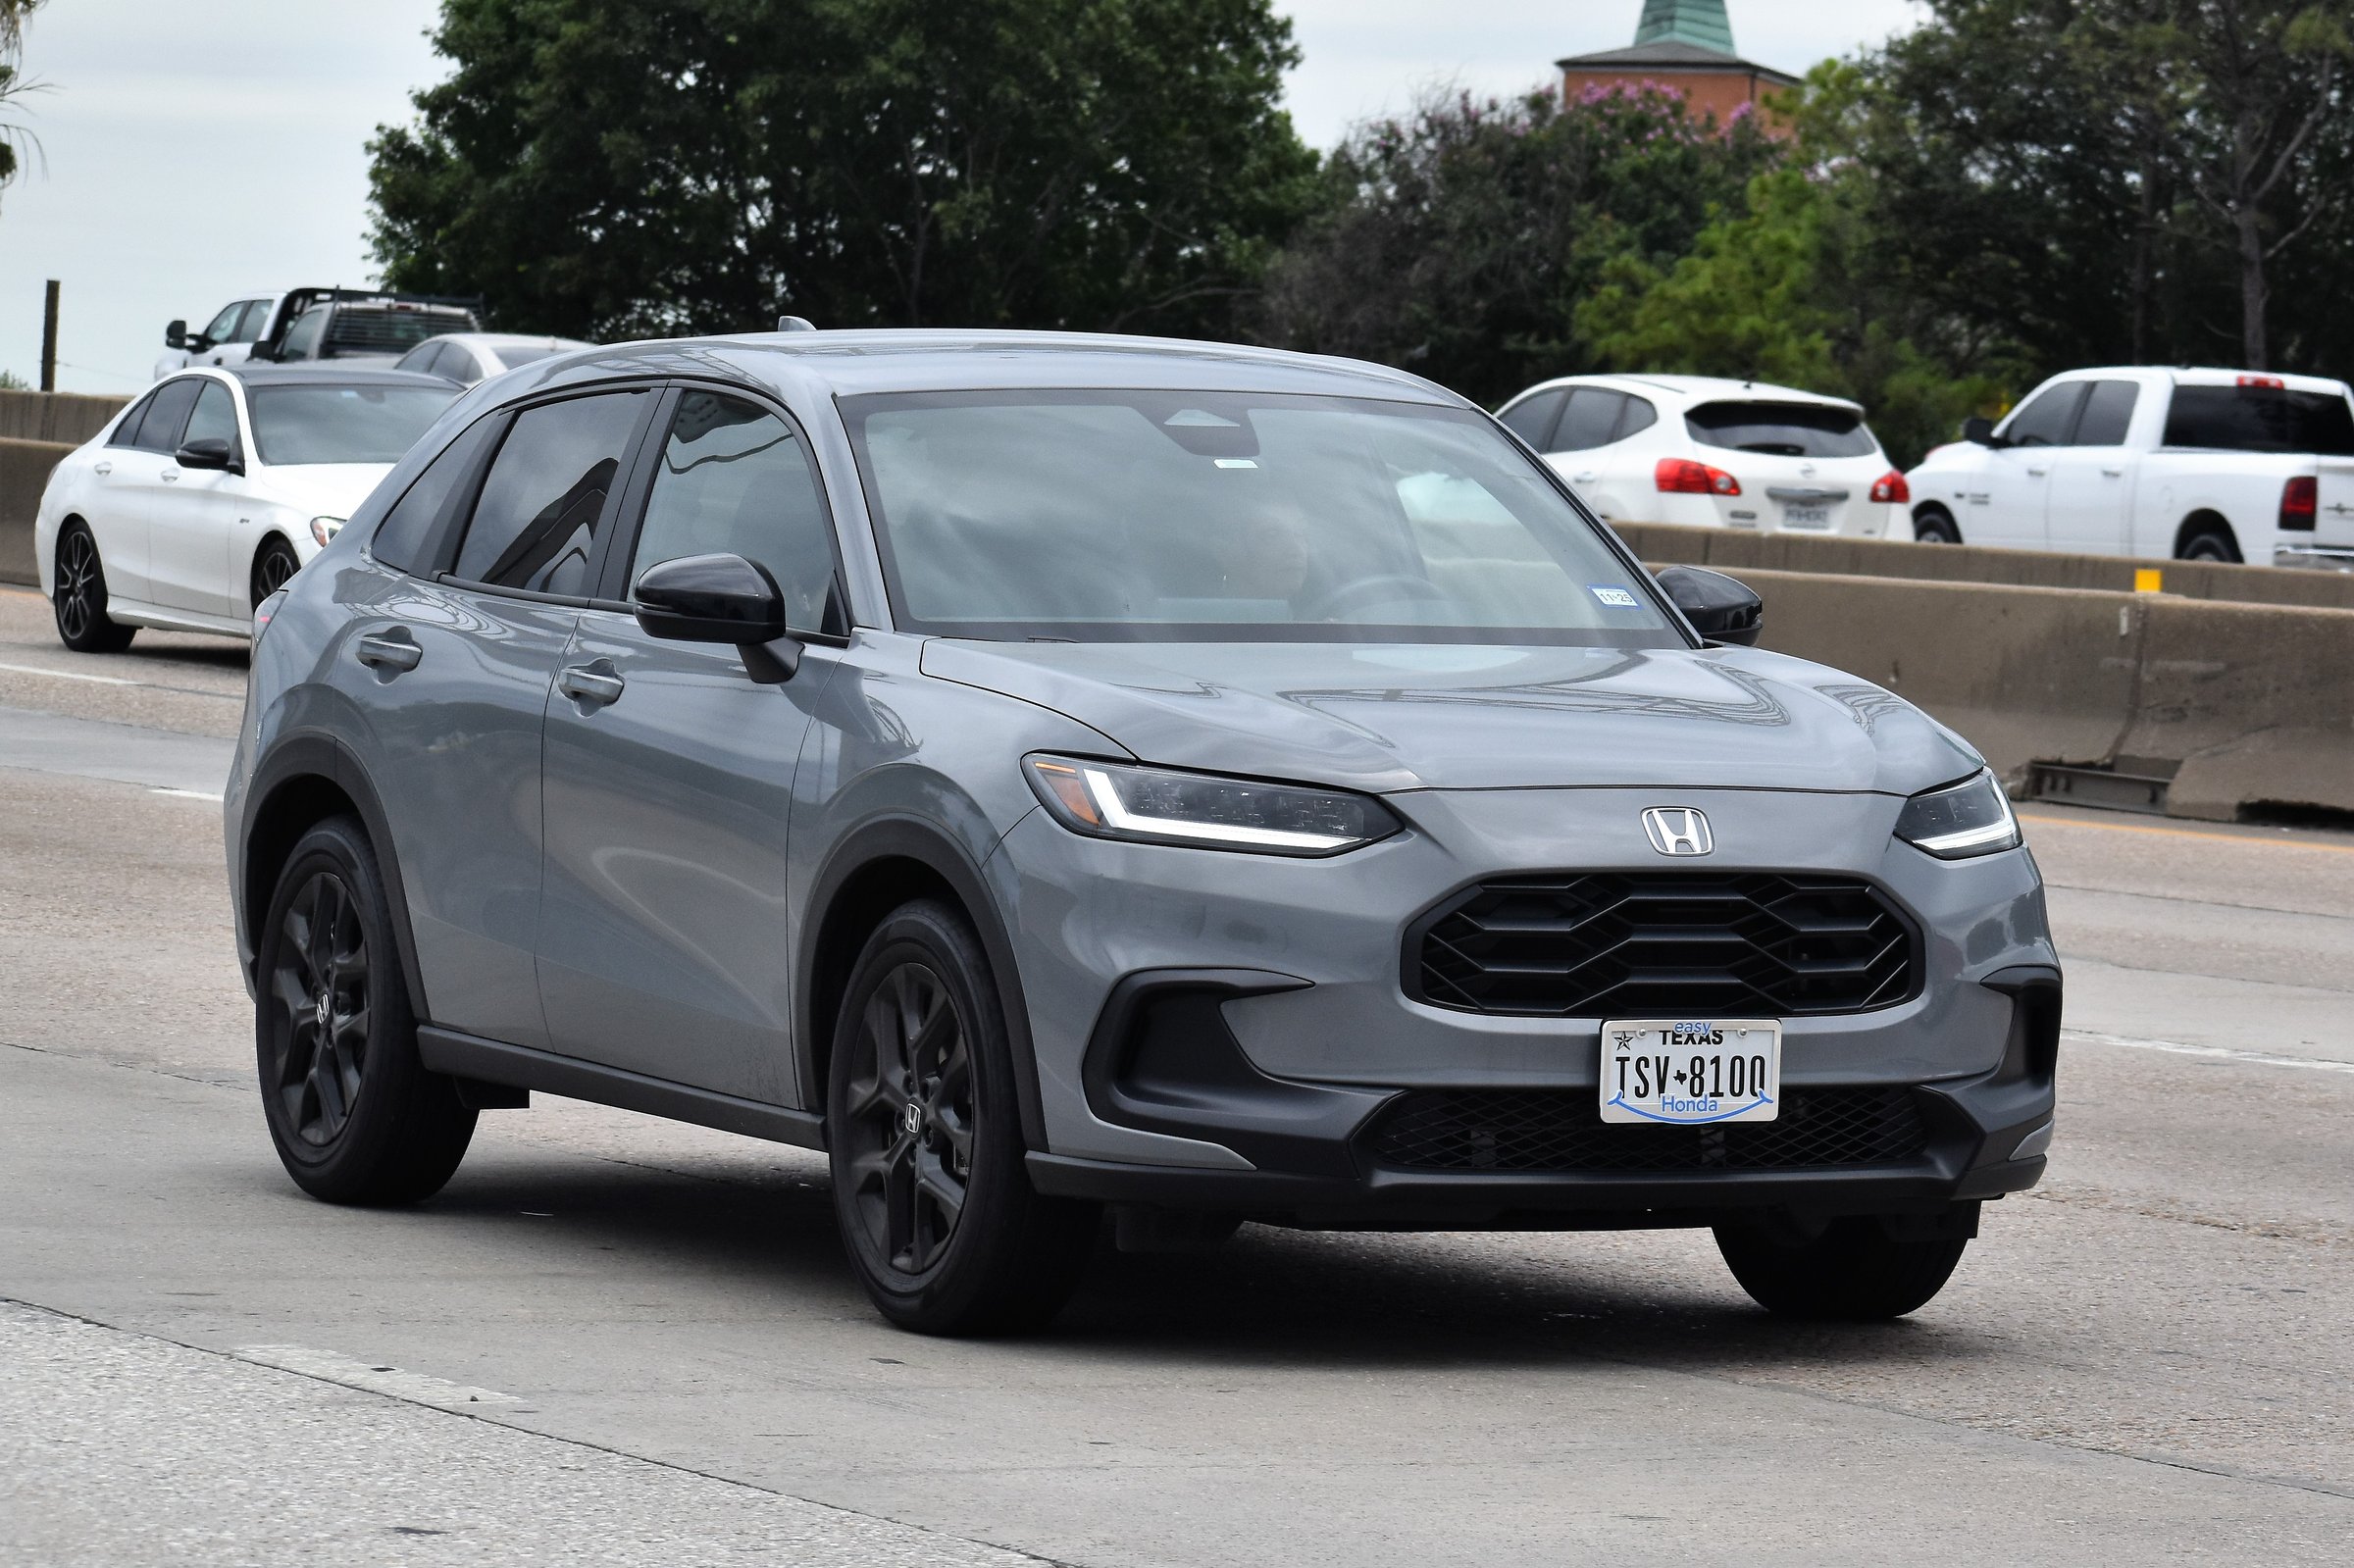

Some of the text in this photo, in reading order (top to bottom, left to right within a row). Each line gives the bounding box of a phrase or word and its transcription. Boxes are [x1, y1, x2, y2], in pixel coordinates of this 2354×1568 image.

[1674, 1022, 1712, 1036] easy
[1659, 1030, 1724, 1045] TEXAS
[1615, 1055, 1766, 1098] TSV 8100
[1662, 1095, 1718, 1113] Honda
